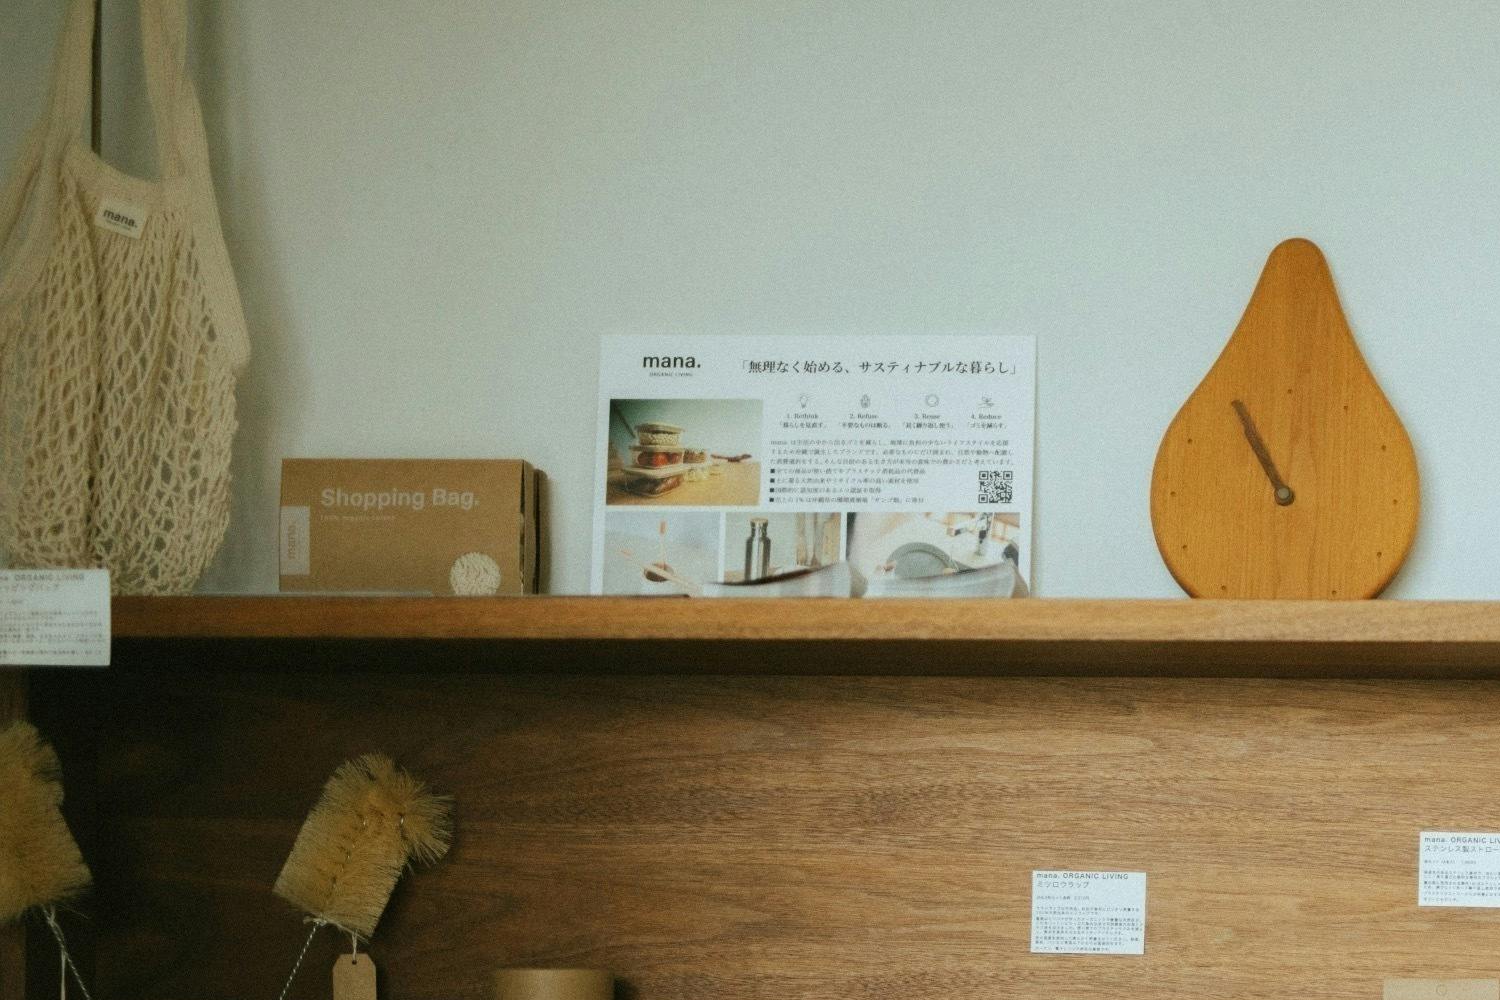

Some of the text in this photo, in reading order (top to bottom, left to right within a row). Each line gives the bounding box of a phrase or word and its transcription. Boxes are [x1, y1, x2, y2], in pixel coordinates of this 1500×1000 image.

[102, 209, 138, 228] mana.
[643, 356, 701, 368] mana.
[740, 359, 1016, 374] 「無理なく始める、サスティナブルな暮らし」
[320, 487, 480, 511] Shopping Bag.
[1063, 872, 1099, 880] ORGANIC
